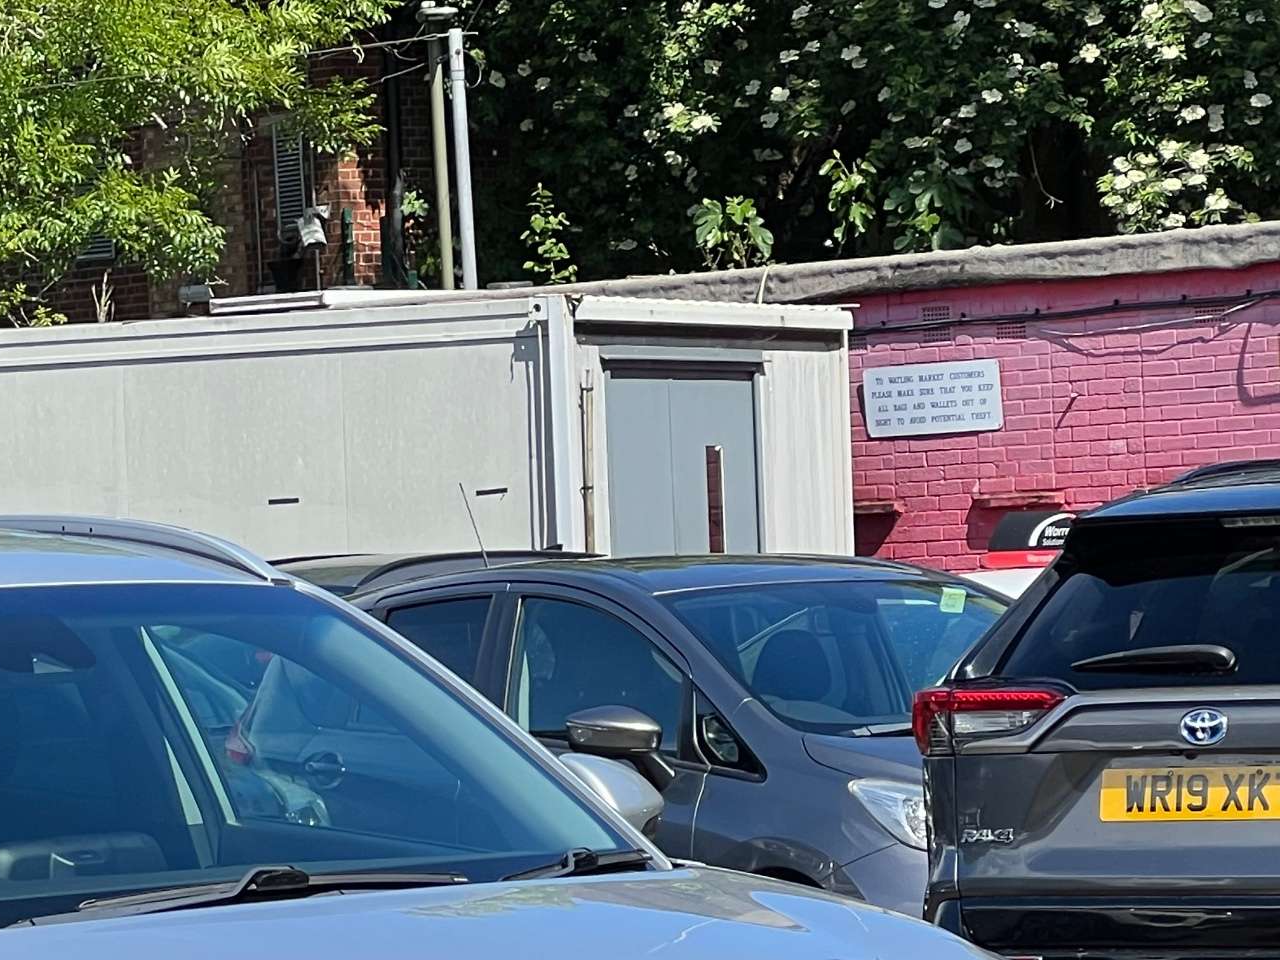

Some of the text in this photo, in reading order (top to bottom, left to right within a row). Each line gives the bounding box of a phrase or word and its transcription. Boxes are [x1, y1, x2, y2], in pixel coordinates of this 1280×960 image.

[875, 370, 984, 385] TO WATLING MARKET CUSTOMERS
[871, 390, 892, 399] PLEASE
[897, 389, 914, 397] MAKE
[919, 387, 934, 396] SURE
[939, 386, 955, 394] THAT
[978, 383, 993, 391] KEEP
[878, 404, 888, 412] ALL
[913, 402, 925, 410] AND
[930, 400, 957, 408] WALLETS
[961, 399, 974, 407] OUT
[875, 411, 991, 426] SIGHT TO AVOID POTENTIAL THEFT
[1126, 773, 1280, 813] WR19 XK
